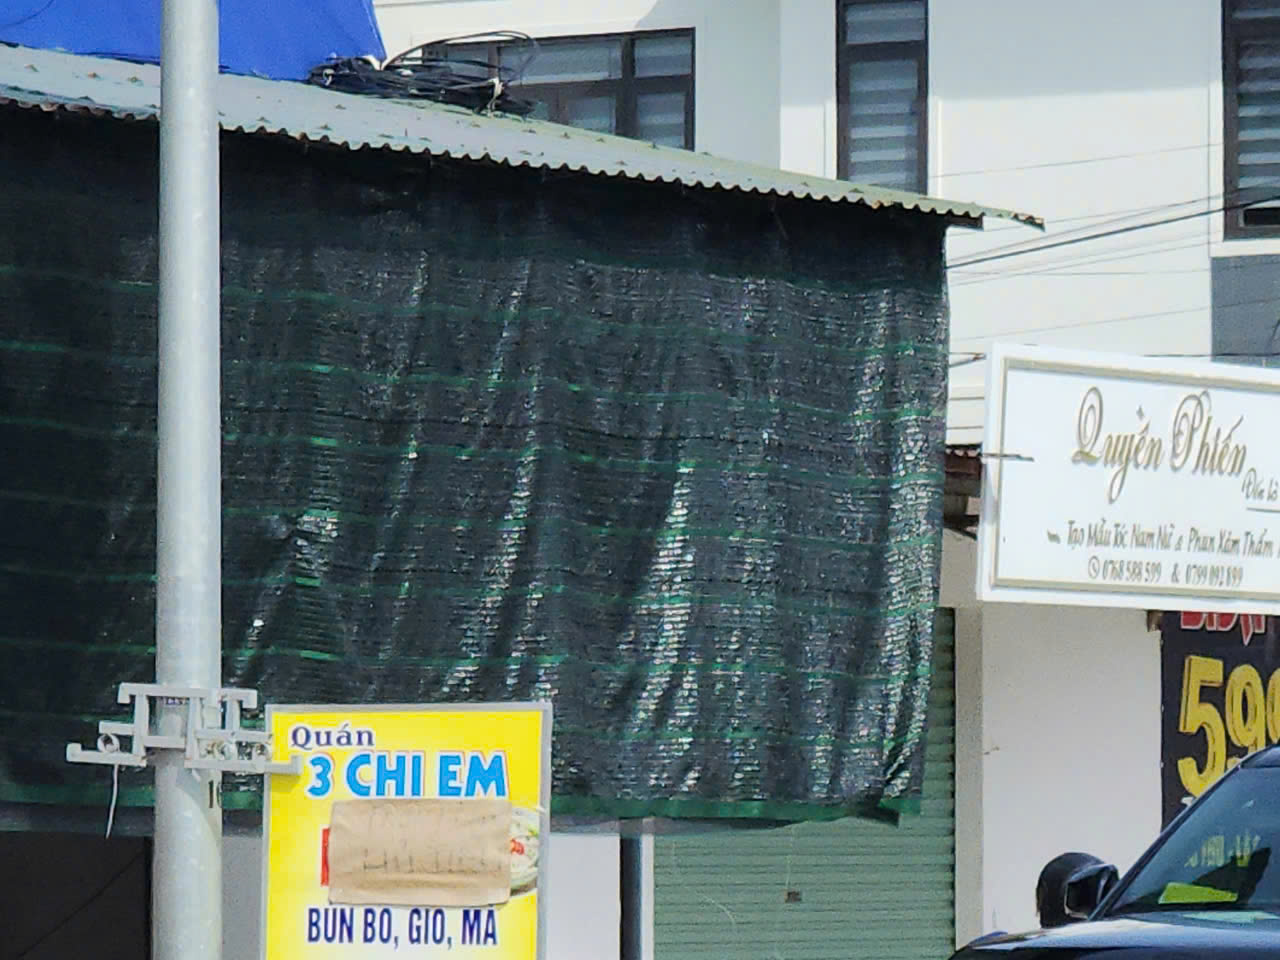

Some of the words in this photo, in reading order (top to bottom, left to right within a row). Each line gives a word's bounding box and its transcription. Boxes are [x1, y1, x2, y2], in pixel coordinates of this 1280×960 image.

[1130, 523, 1155, 549] Nam
[291, 724, 374, 747] Quán
[307, 755, 332, 797] 3
[439, 755, 506, 797] EM
